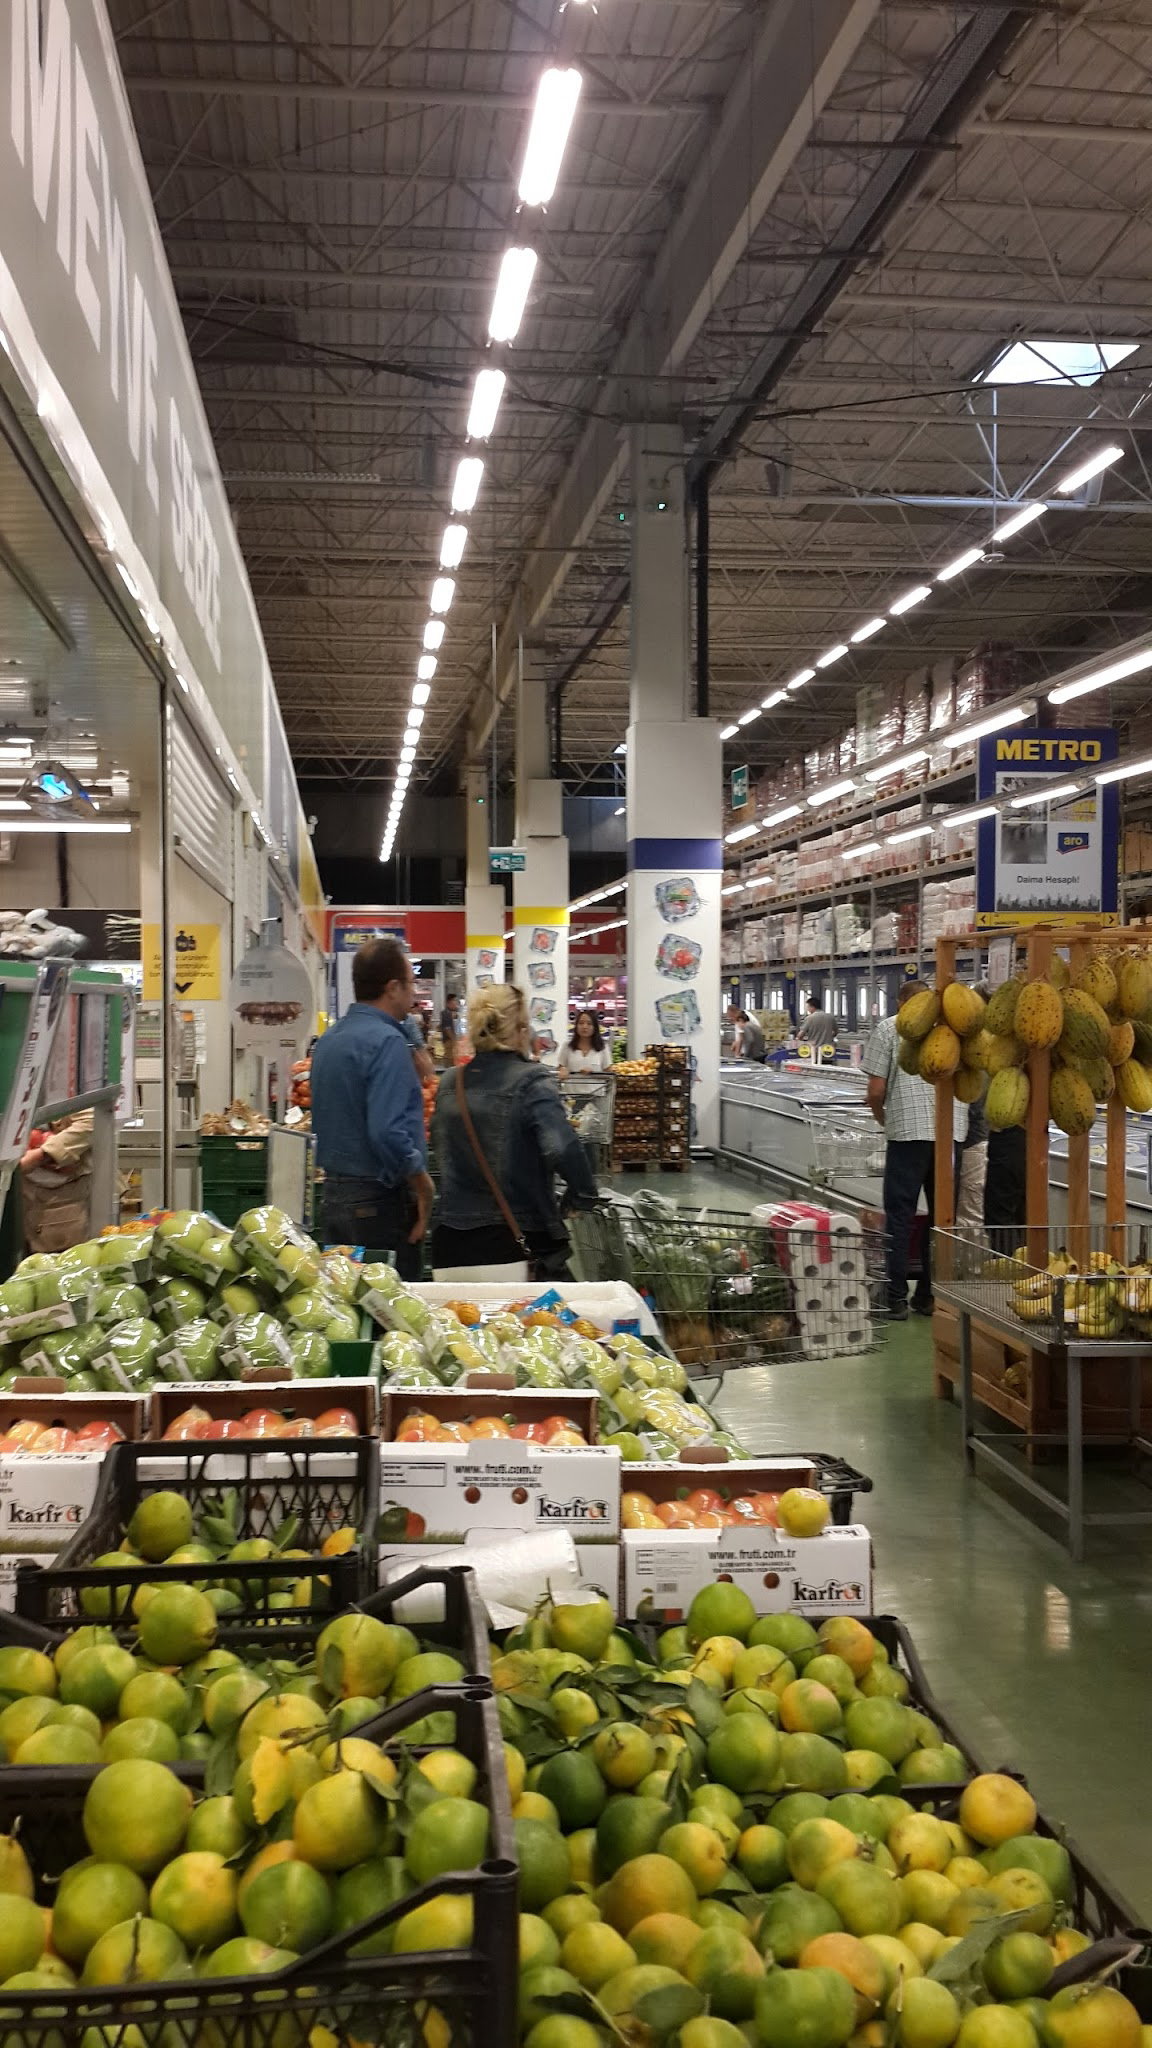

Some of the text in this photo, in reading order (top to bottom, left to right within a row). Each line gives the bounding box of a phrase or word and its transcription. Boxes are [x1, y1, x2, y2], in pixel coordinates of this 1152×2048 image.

[170, 396, 222, 674] SEBZE
[996, 739, 1102, 762] METRO
[1063, 835, 1083, 846] aro
[1016, 875, 1080, 885] Daima Hesaplı!
